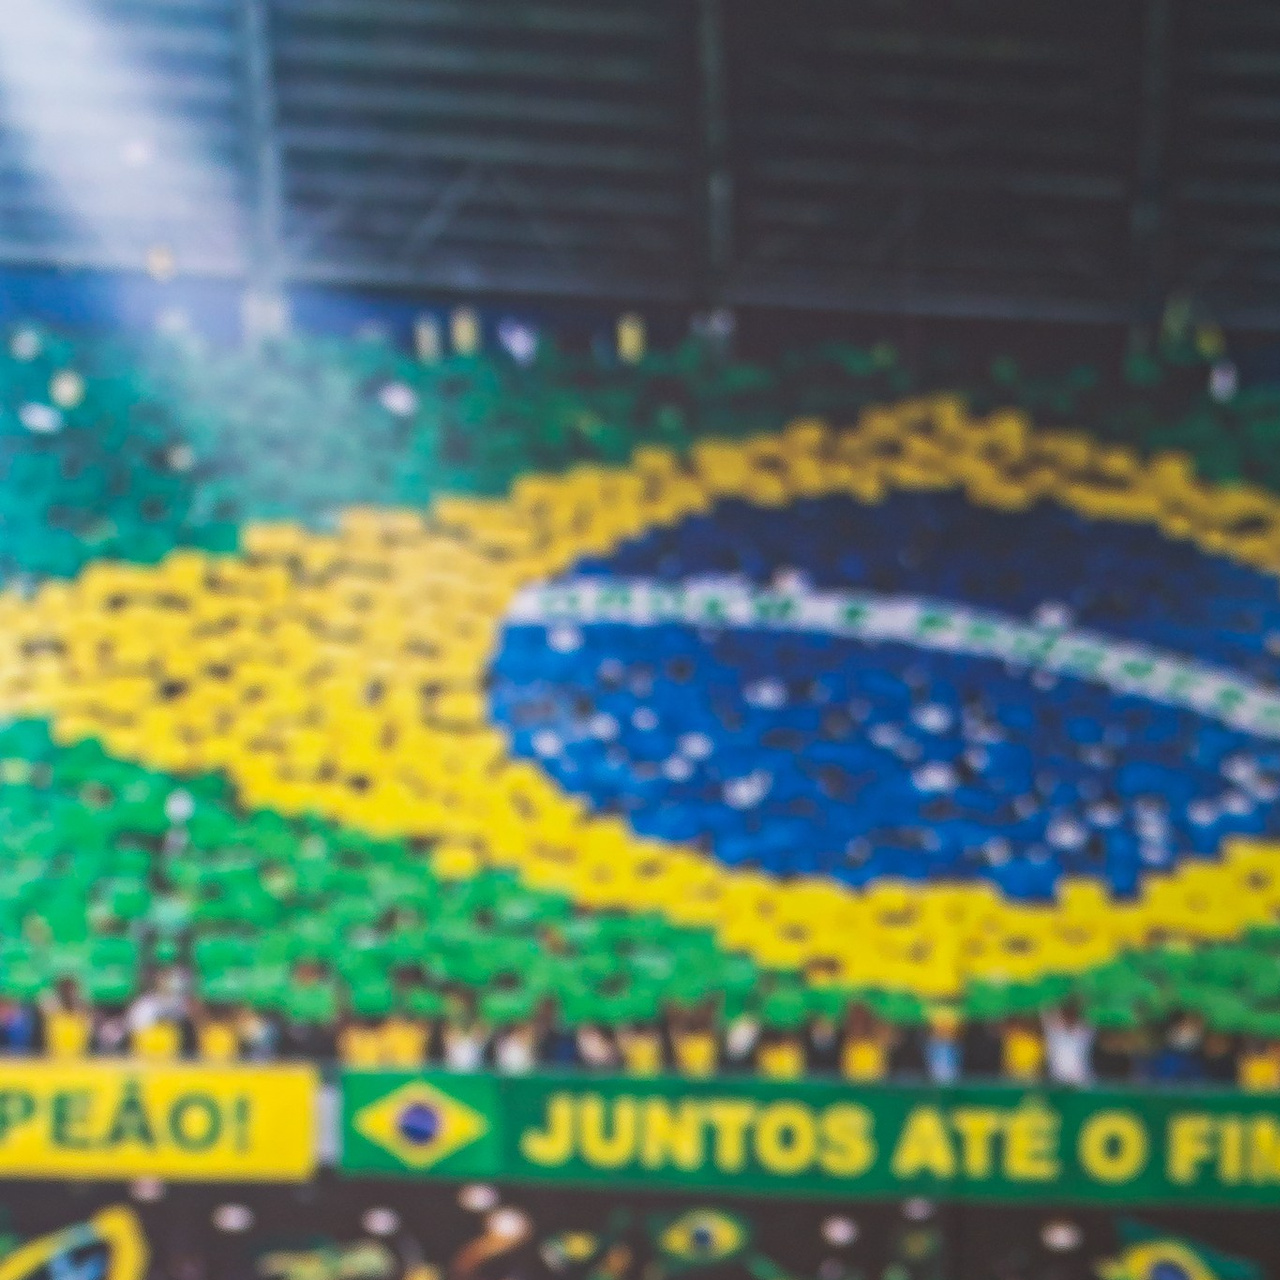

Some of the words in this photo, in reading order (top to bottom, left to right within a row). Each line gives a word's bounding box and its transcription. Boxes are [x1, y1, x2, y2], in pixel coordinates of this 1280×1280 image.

[520, 1092, 875, 1176] JUNTOS
[890, 1096, 1060, 1182] ATÉ
[1078, 1108, 1148, 1182] O
